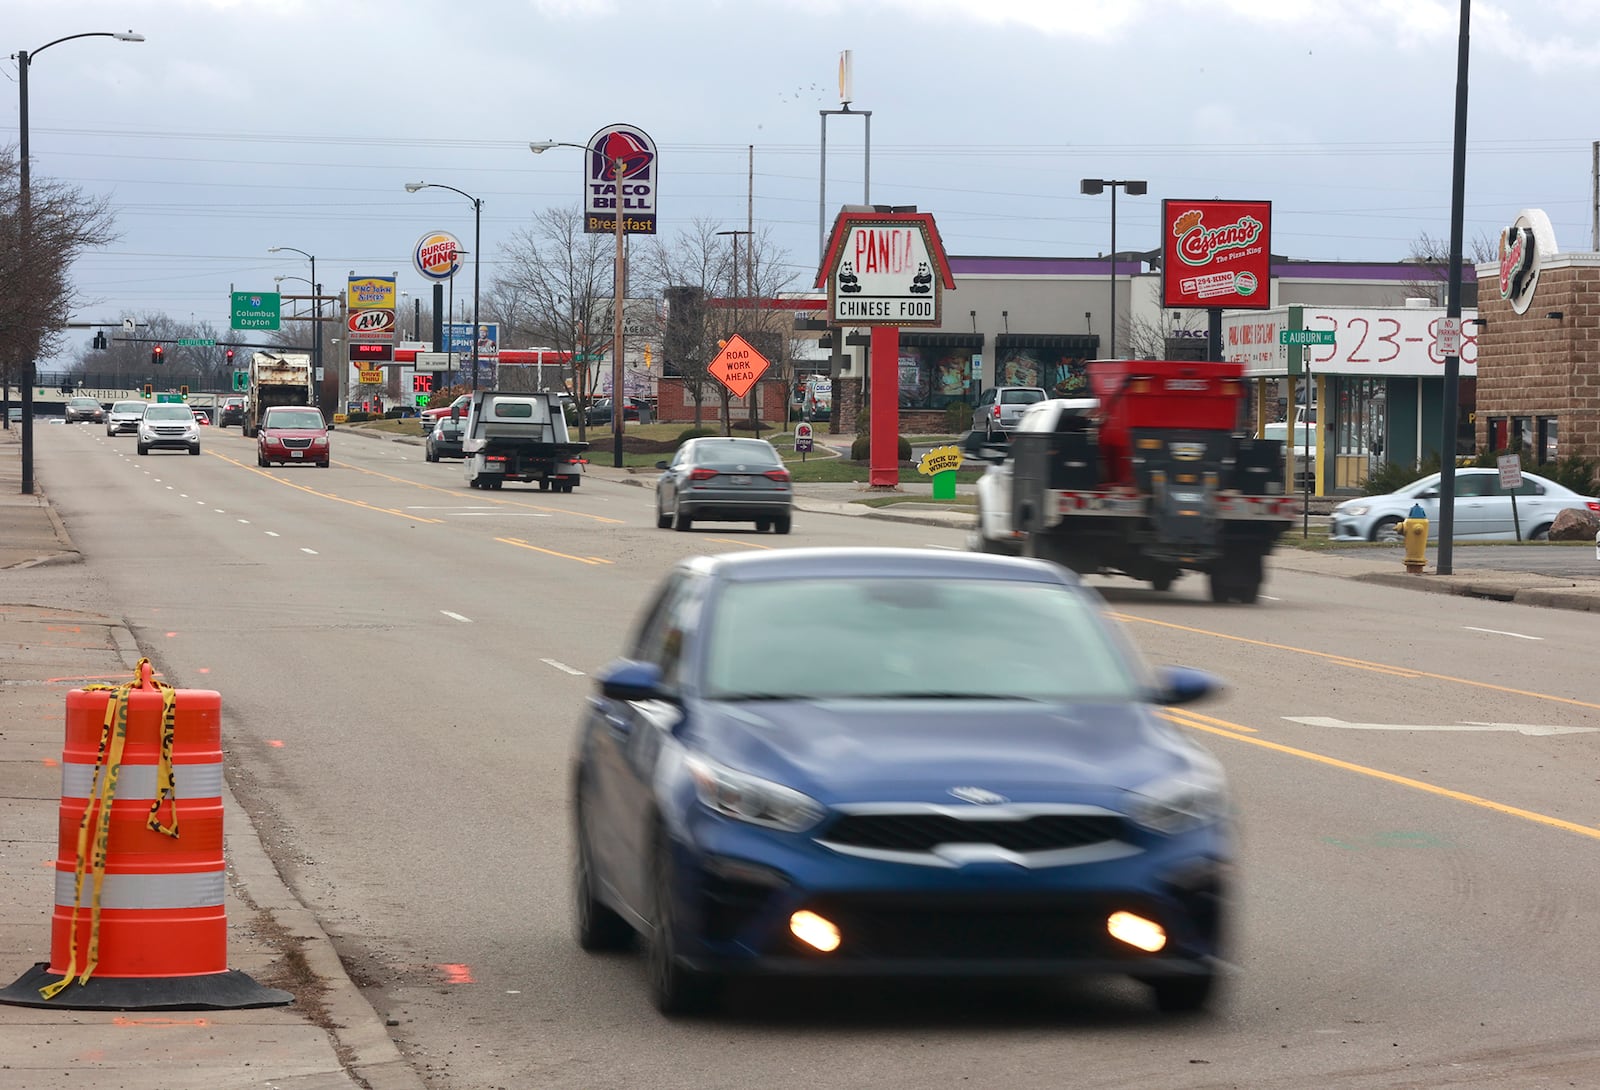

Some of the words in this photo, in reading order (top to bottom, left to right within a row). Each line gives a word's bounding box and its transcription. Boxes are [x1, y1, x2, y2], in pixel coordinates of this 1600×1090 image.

[590, 184, 651, 196] TACO
[1180, 220, 1260, 262] Cassano's
[421, 242, 456, 257] BURGER
[855, 229, 914, 274] PANDA
[1216, 255, 1228, 264] The
[1229, 252, 1246, 261] Pizza
[1246, 246, 1263, 256] King
[423, 250, 458, 269] KING
[1198, 273, 1233, 285] 294-KING
[251, 298, 261, 306] 70
[236, 310, 276, 318] Columbus
[840, 301, 891, 316] CHINESE
[900, 302, 932, 316] FOOD
[241, 318, 271, 328] Dayton
[1444, 319, 1454, 329] NO
[607, 326, 650, 334] MAGERS
[1282, 332, 1288, 343] E
[1289, 332, 1322, 343] AUBURN
[1324, 334, 1333, 342] AVE
[726, 350, 749, 360] ROAD
[727, 361, 751, 371] WORK
[725, 371, 754, 382] AHEAD
[928, 455, 946, 466] PICK
[928, 461, 959, 473] WINDOW
